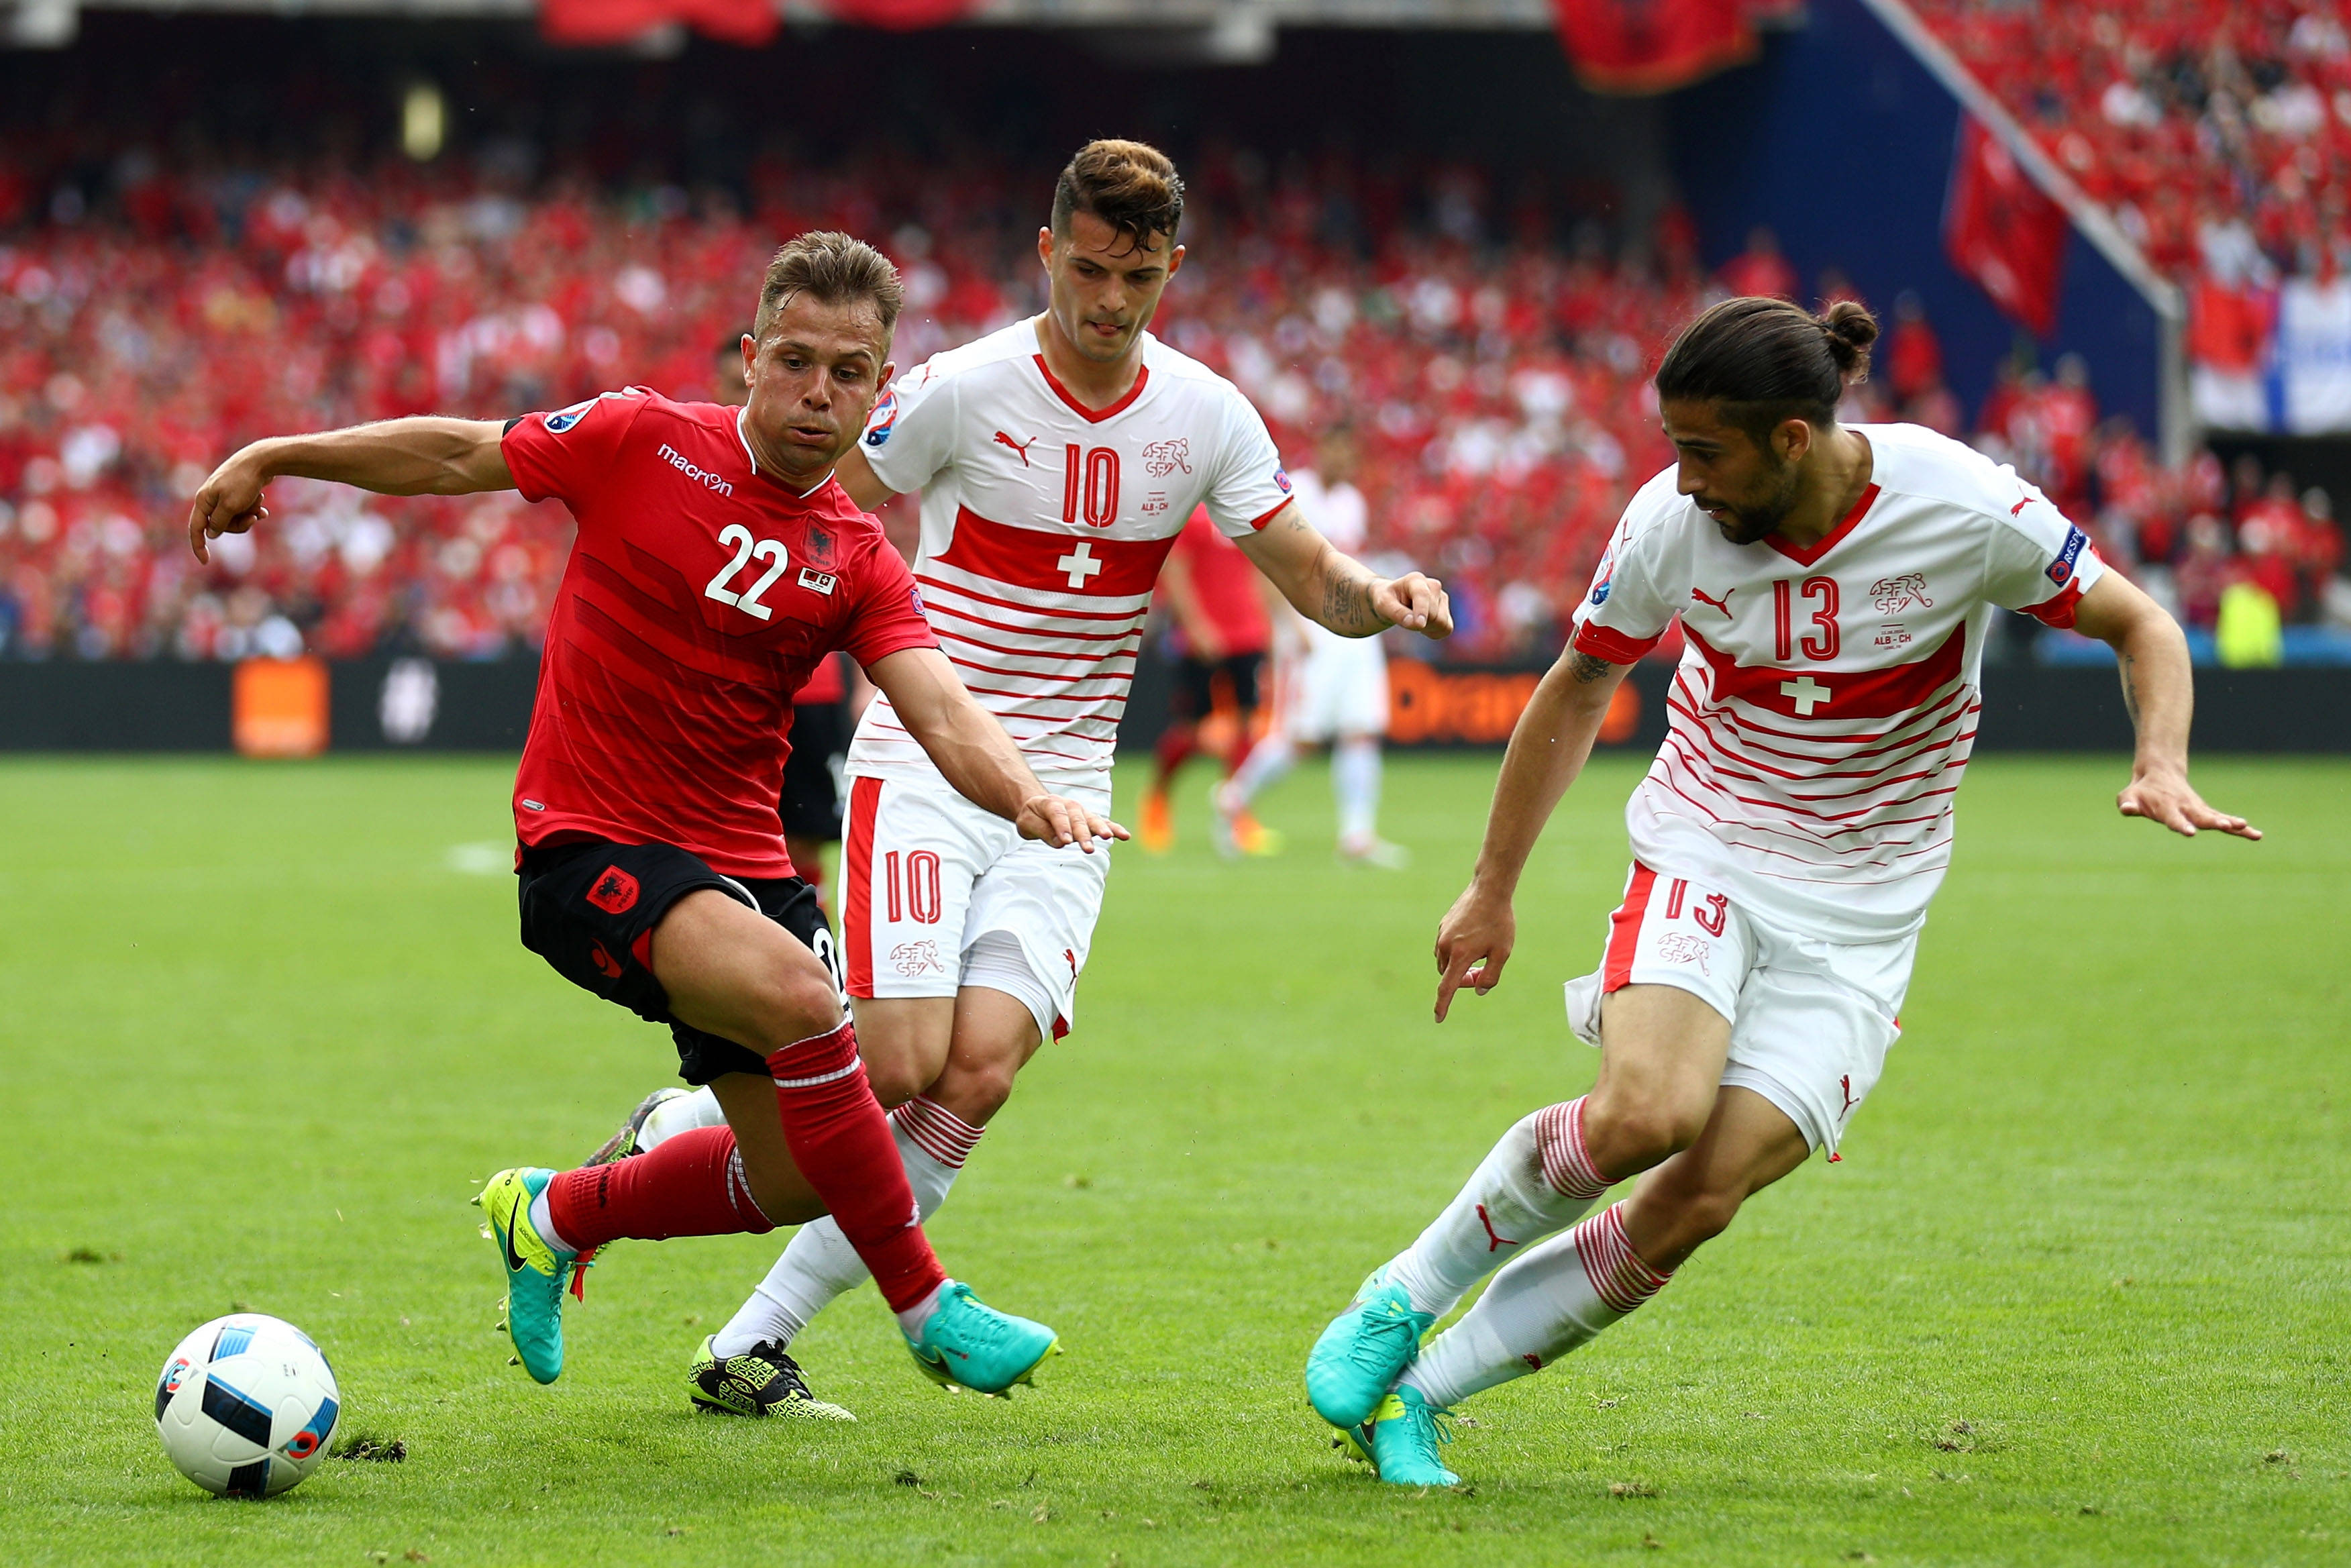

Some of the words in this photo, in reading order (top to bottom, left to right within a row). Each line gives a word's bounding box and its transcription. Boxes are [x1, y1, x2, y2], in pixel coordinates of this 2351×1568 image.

[657, 443, 733, 497] macron
[1063, 443, 1120, 528] 10
[1141, 503, 1154, 511] ALB
[1159, 502, 1168, 510] CH
[704, 523, 788, 621] 22
[2064, 526, 2083, 564] RESPE
[1772, 576, 1840, 662] 13
[1874, 636, 1891, 645] ALB
[1899, 633, 1912, 643] CH
[885, 849, 941, 925] 10
[1665, 878, 1728, 937] 13
[813, 930, 853, 1023] 2
